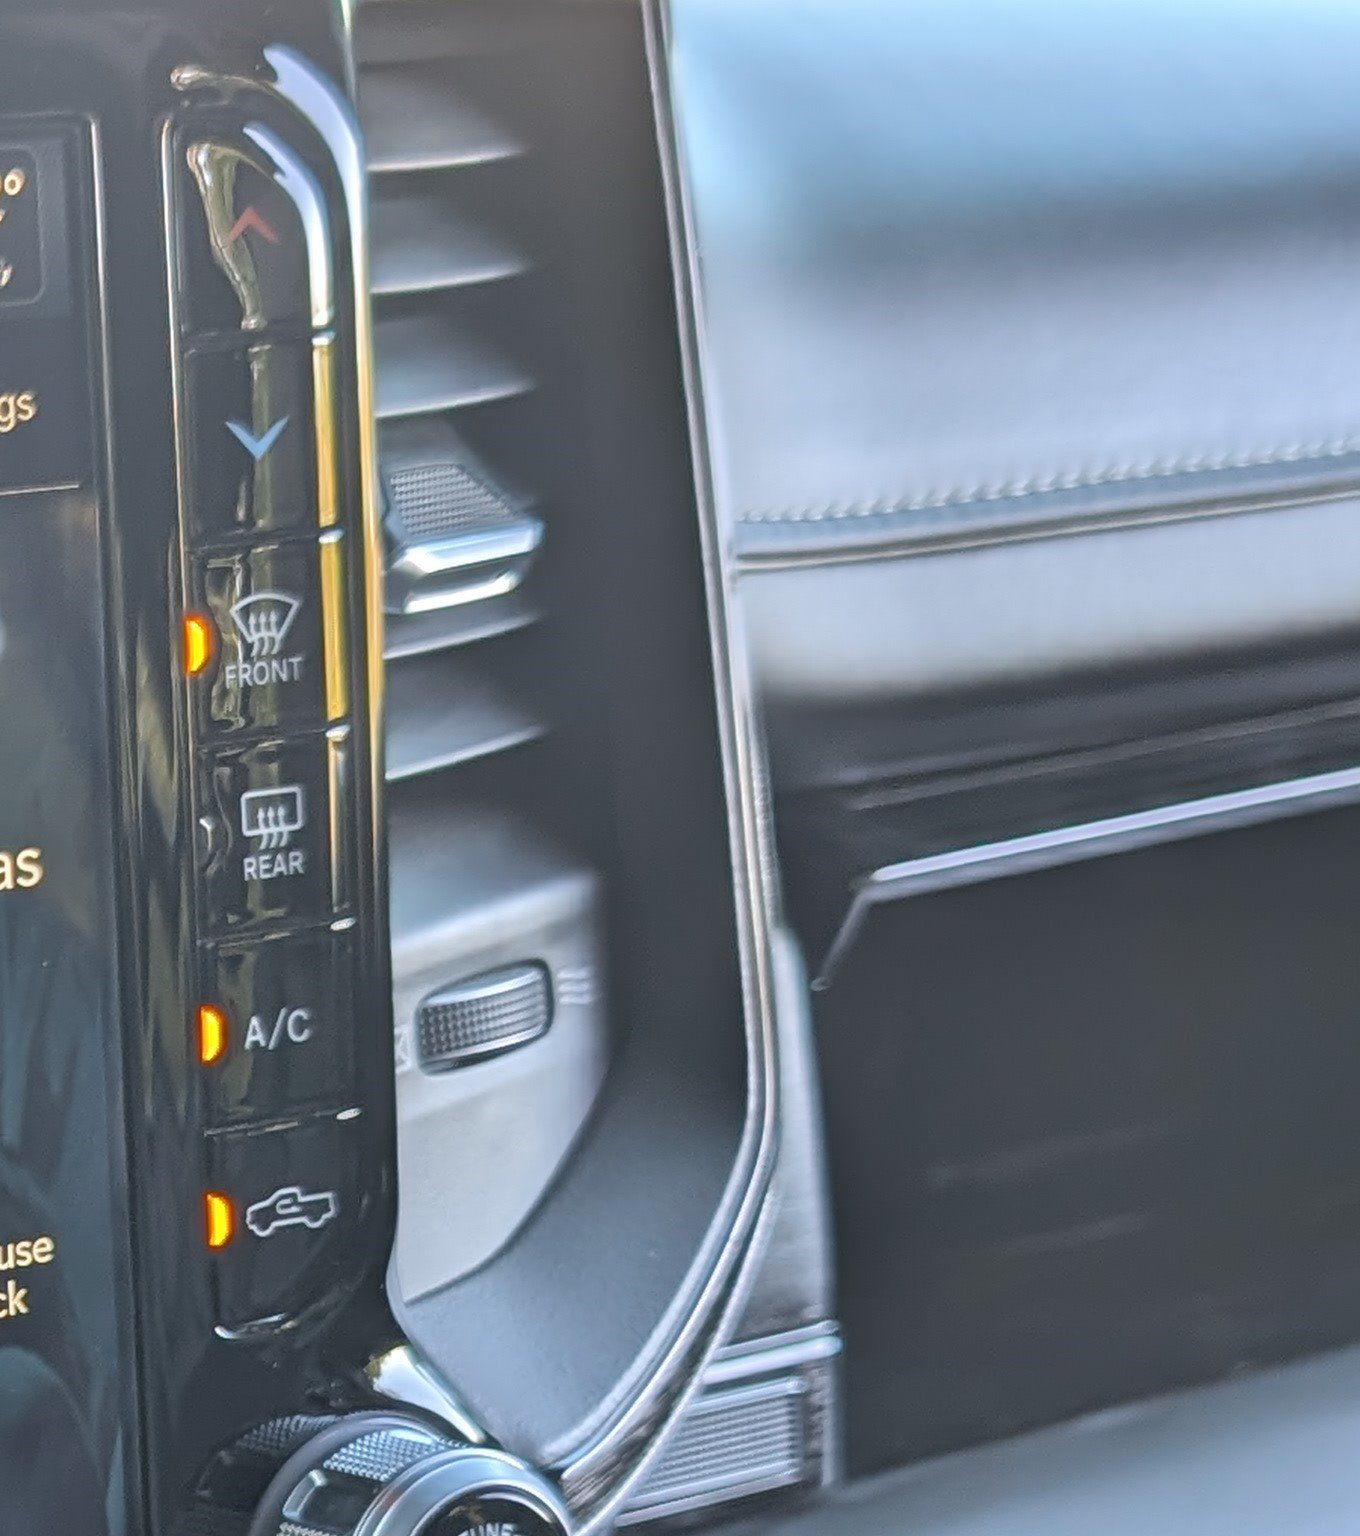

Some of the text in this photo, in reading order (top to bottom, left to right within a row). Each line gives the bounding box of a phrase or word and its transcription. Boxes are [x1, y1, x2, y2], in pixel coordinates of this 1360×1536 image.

[225, 656, 305, 690] FRONT
[243, 851, 305, 882] REAR
[244, 1007, 313, 1050] A/C
